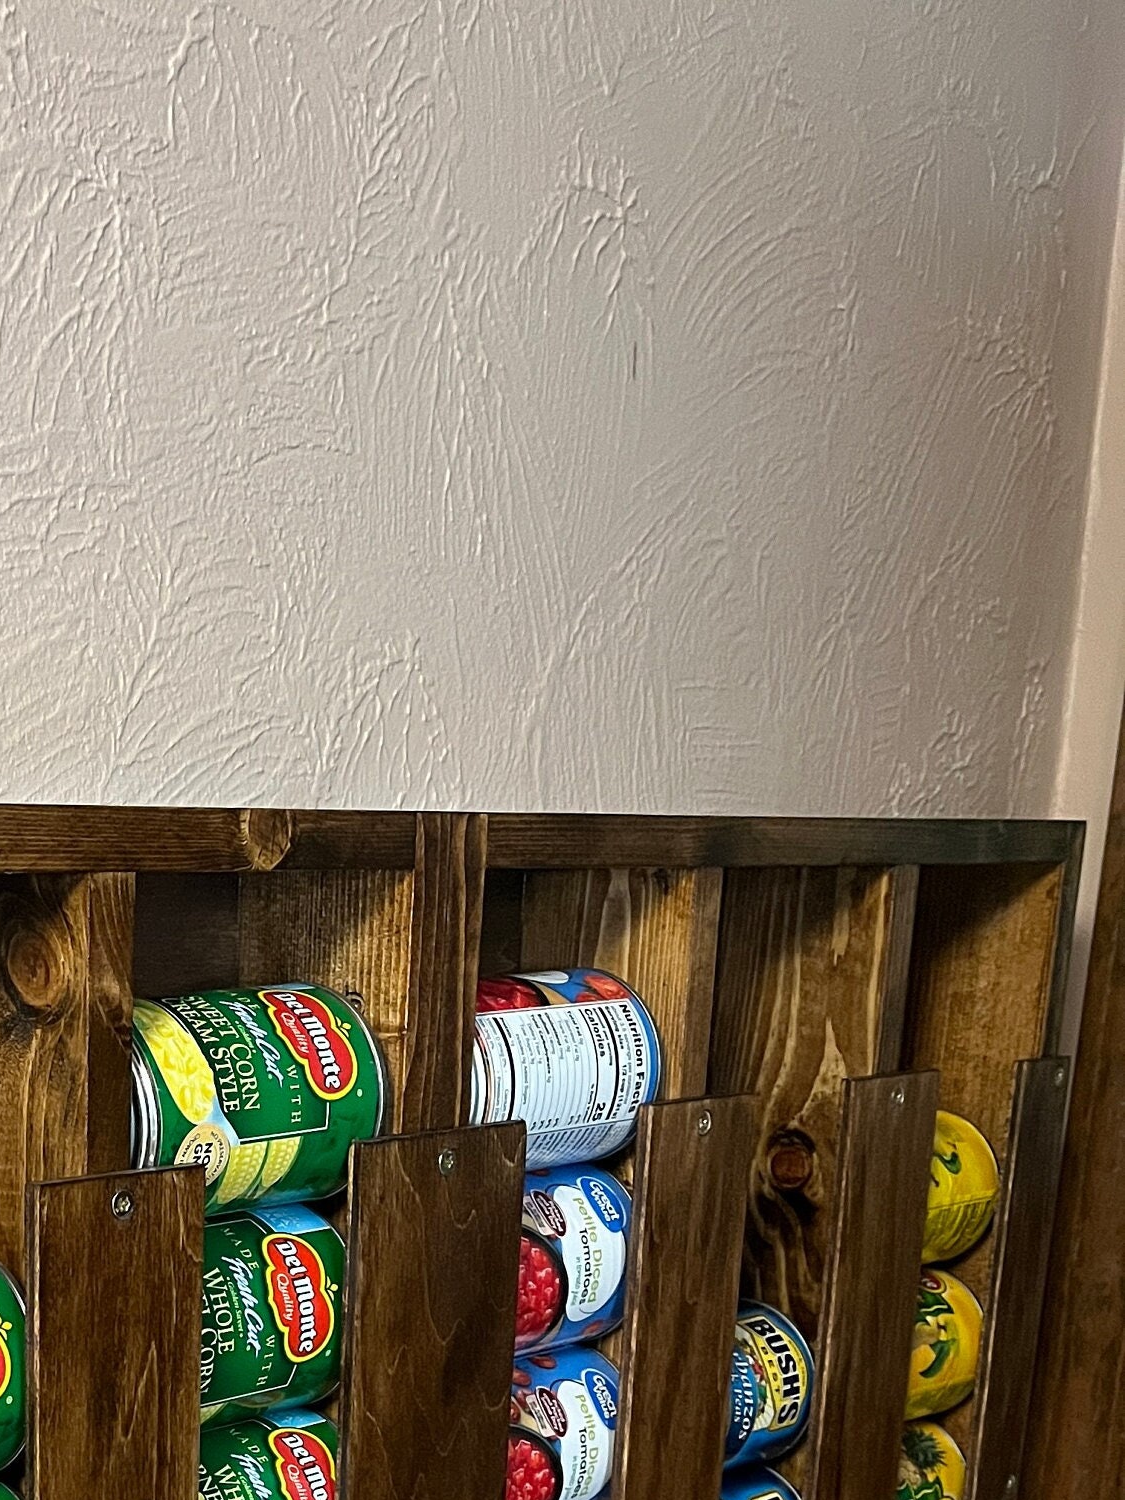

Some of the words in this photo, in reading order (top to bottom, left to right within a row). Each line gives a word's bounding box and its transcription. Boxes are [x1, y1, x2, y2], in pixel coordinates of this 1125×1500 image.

[274, 992, 309, 1018] Del
[303, 1016, 341, 1089] Monte
[281, 1012, 309, 1054] Quality
[584, 1008, 606, 1057] Calories
[619, 1004, 644, 1067] Nutrition
[210, 1047, 240, 1113] STYLE
[229, 1044, 260, 1111] CORN
[285, 1065, 302, 1124] WITH
[628, 1071, 645, 1113] Facts
[593, 1102, 606, 1121] 25
[222, 1228, 260, 1270] MADE
[579, 1229, 593, 1305] Tomatoes
[203, 1268, 235, 1355] WHOLE
[275, 1241, 307, 1275] Del
[294, 1272, 317, 1352] Monte
[277, 1273, 294, 1321] Quality
[244, 1308, 264, 1358] Cut
[257, 1335, 275, 1386] WITH
[745, 1320, 800, 1424] BUSH'S
[282, 1434, 317, 1466] Del
[571, 1427, 588, 1499] Tomatoes
